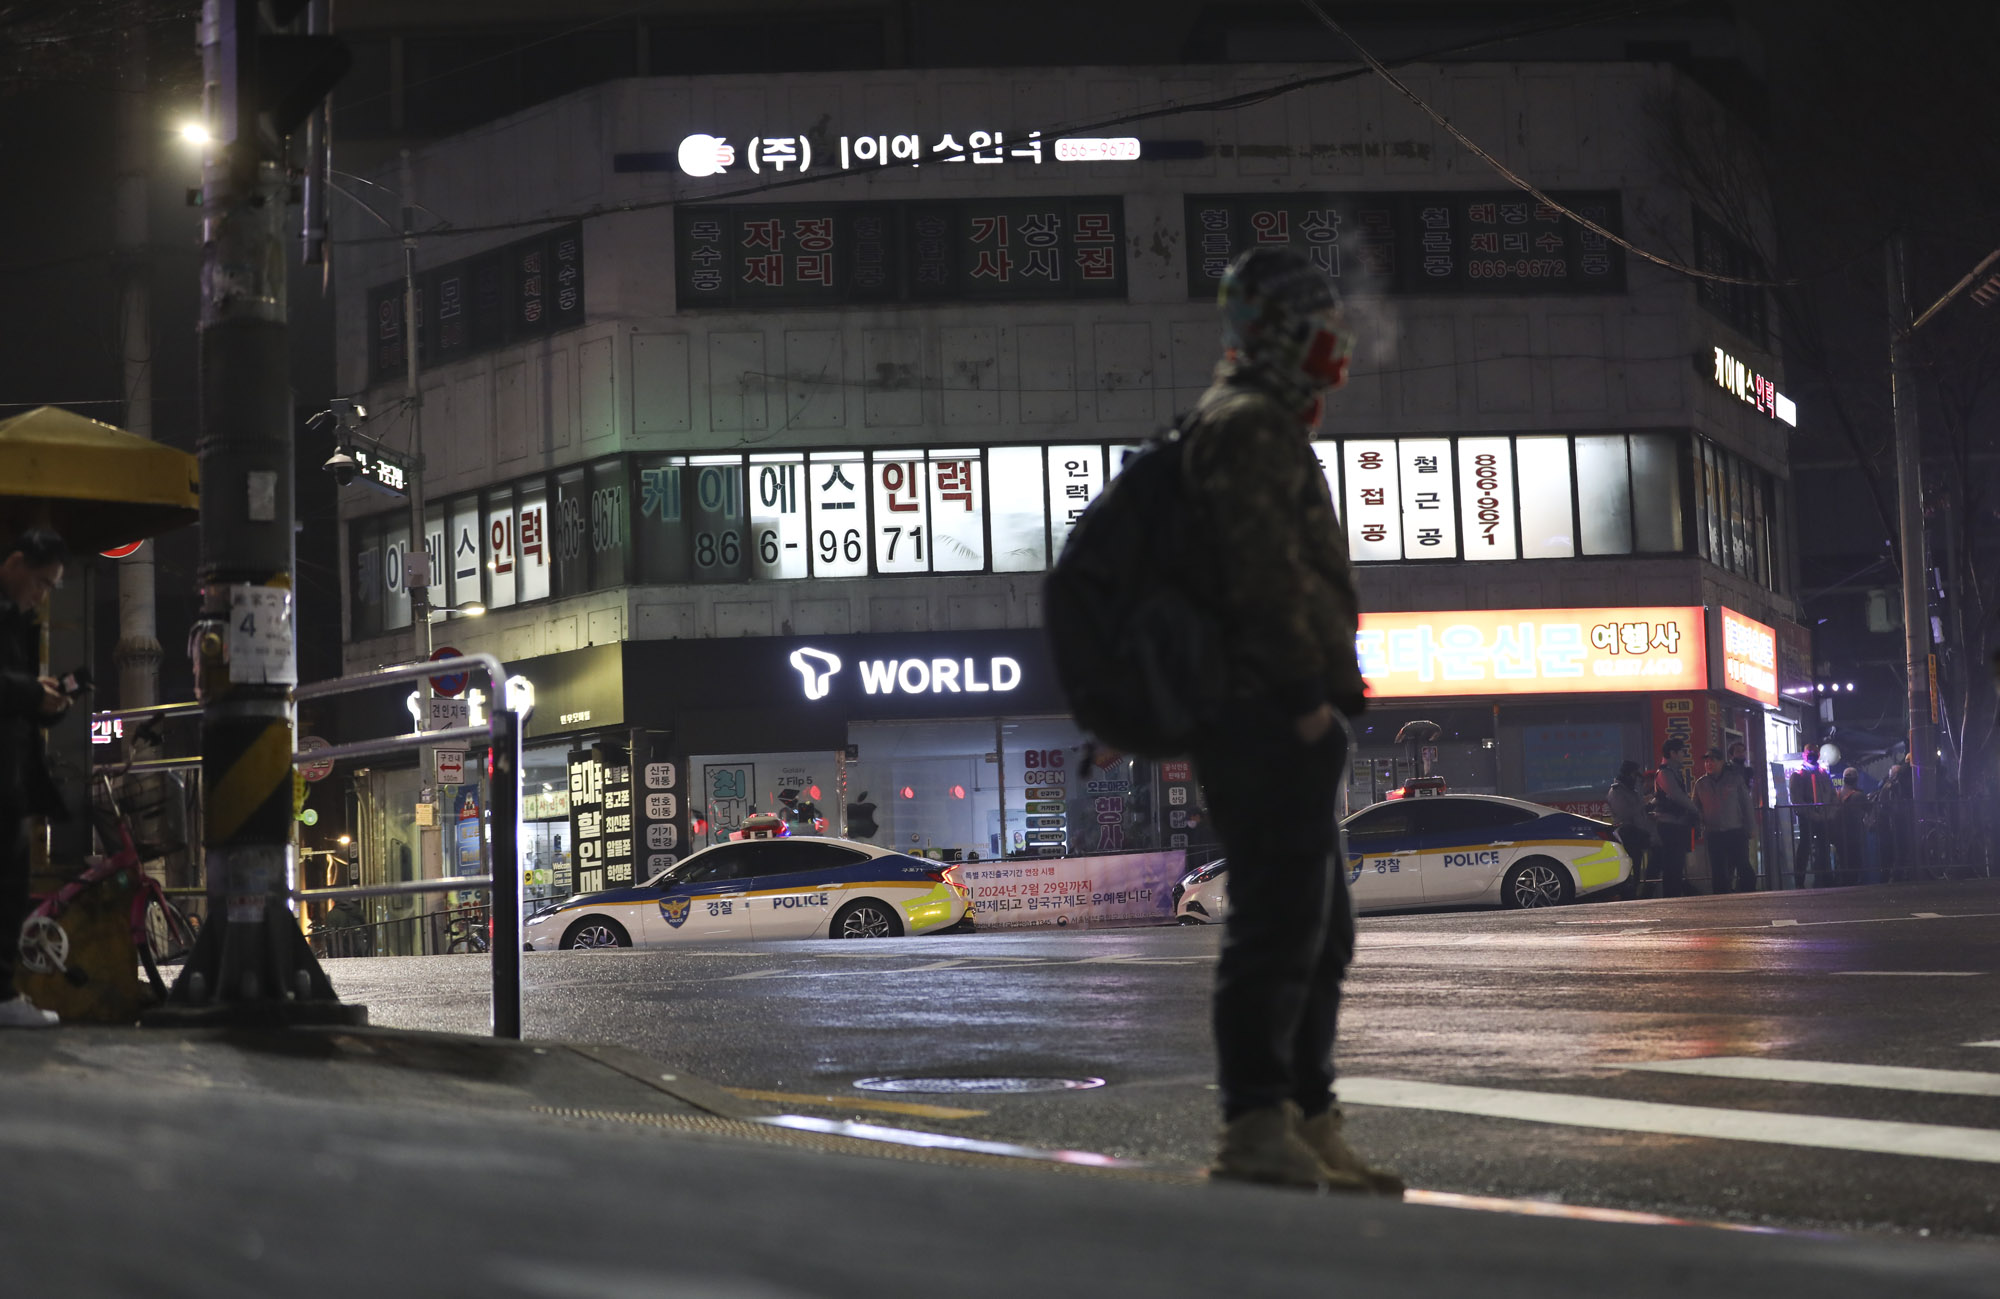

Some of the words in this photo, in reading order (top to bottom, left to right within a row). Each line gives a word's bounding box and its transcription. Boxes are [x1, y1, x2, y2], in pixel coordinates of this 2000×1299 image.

[747, 133, 811, 173] (주)
[1060, 142, 1136, 157] 866-9672
[558, 240, 577, 311] 목수공
[1469, 258, 1567, 279] 866-9672
[641, 461, 974, 522] 케이에스인력
[1357, 451, 1387, 542] 용접공
[1414, 456, 1443, 546] 철근공
[695, 526, 926, 568] 866-9671
[239, 612, 256, 637] 4
[1590, 621, 1681, 656] 여행사
[859, 657, 1021, 694] WORLD
[432, 704, 467, 719] 견인지역
[1025, 749, 1064, 768] BIG
[650, 766, 671, 775] 신규
[1024, 770, 1066, 785] OPEN
[650, 776, 671, 786] 개통
[778, 777, 785, 786] Z
[806, 776, 813, 785] 5
[605, 790, 630, 809] 중고폰
[651, 797, 672, 806] 번호
[651, 807, 672, 817] 이동
[605, 814, 630, 833] 최신폰
[652, 827, 672, 836] 기기
[652, 837, 672, 847] 변경
[653, 857, 672, 866] 요금
[1375, 858, 1400, 874] 경찰
[1444, 852, 1499, 867] POLICE
[965, 871, 979, 880] 특별
[1024, 868, 1039, 877] 연장
[1041, 867, 1055, 876] 시행
[978, 885, 1017, 898] 2024년
[1020, 883, 1039, 897] 2월
[1043, 880, 1092, 895] 29일까지
[706, 900, 733, 917] 경찰
[773, 893, 828, 909] POLICE
[1028, 894, 1087, 911] 입국규제도
[1091, 889, 1152, 906] 유예됩니다
